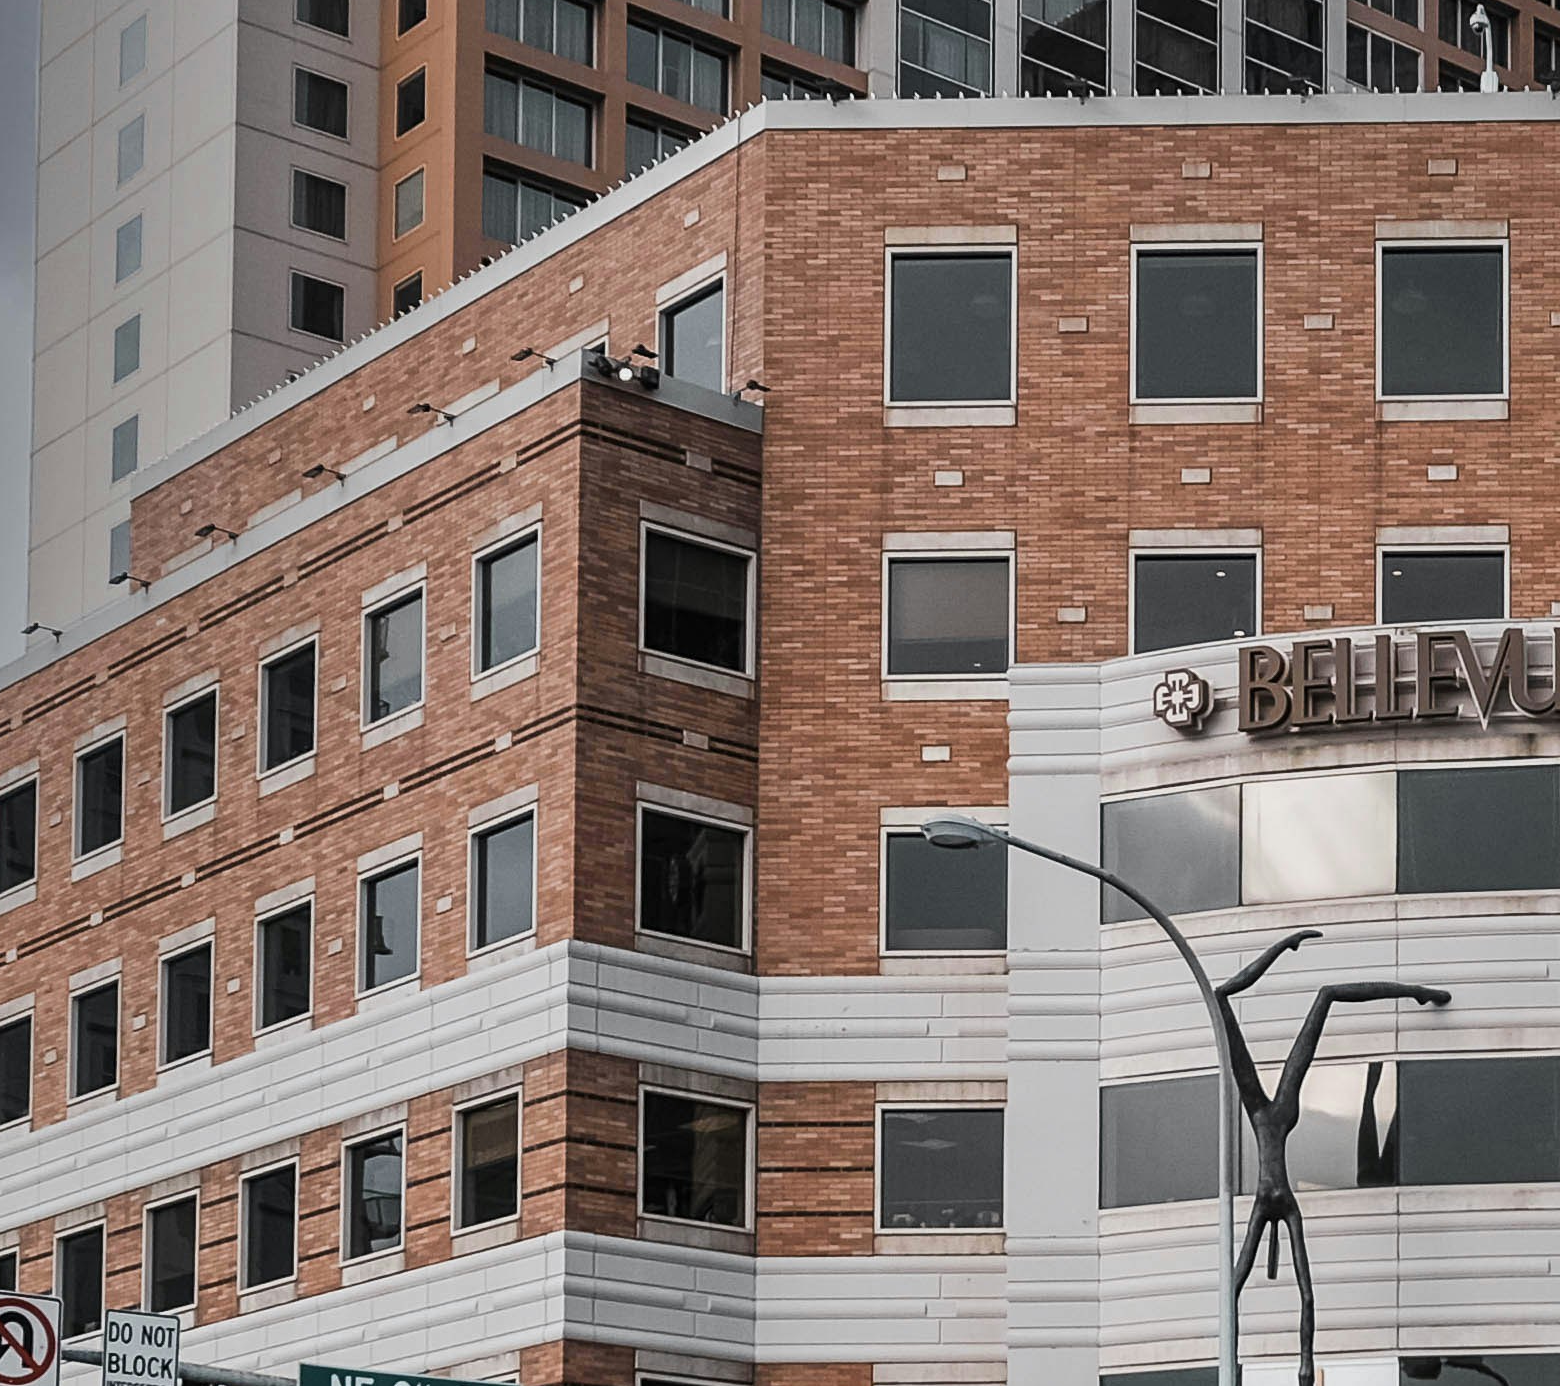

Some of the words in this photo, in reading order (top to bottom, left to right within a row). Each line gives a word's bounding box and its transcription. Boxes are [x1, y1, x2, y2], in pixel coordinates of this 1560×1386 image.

[108, 1321, 133, 1344] DO
[141, 1324, 175, 1348] NOT
[108, 1352, 173, 1380] BLOCK
